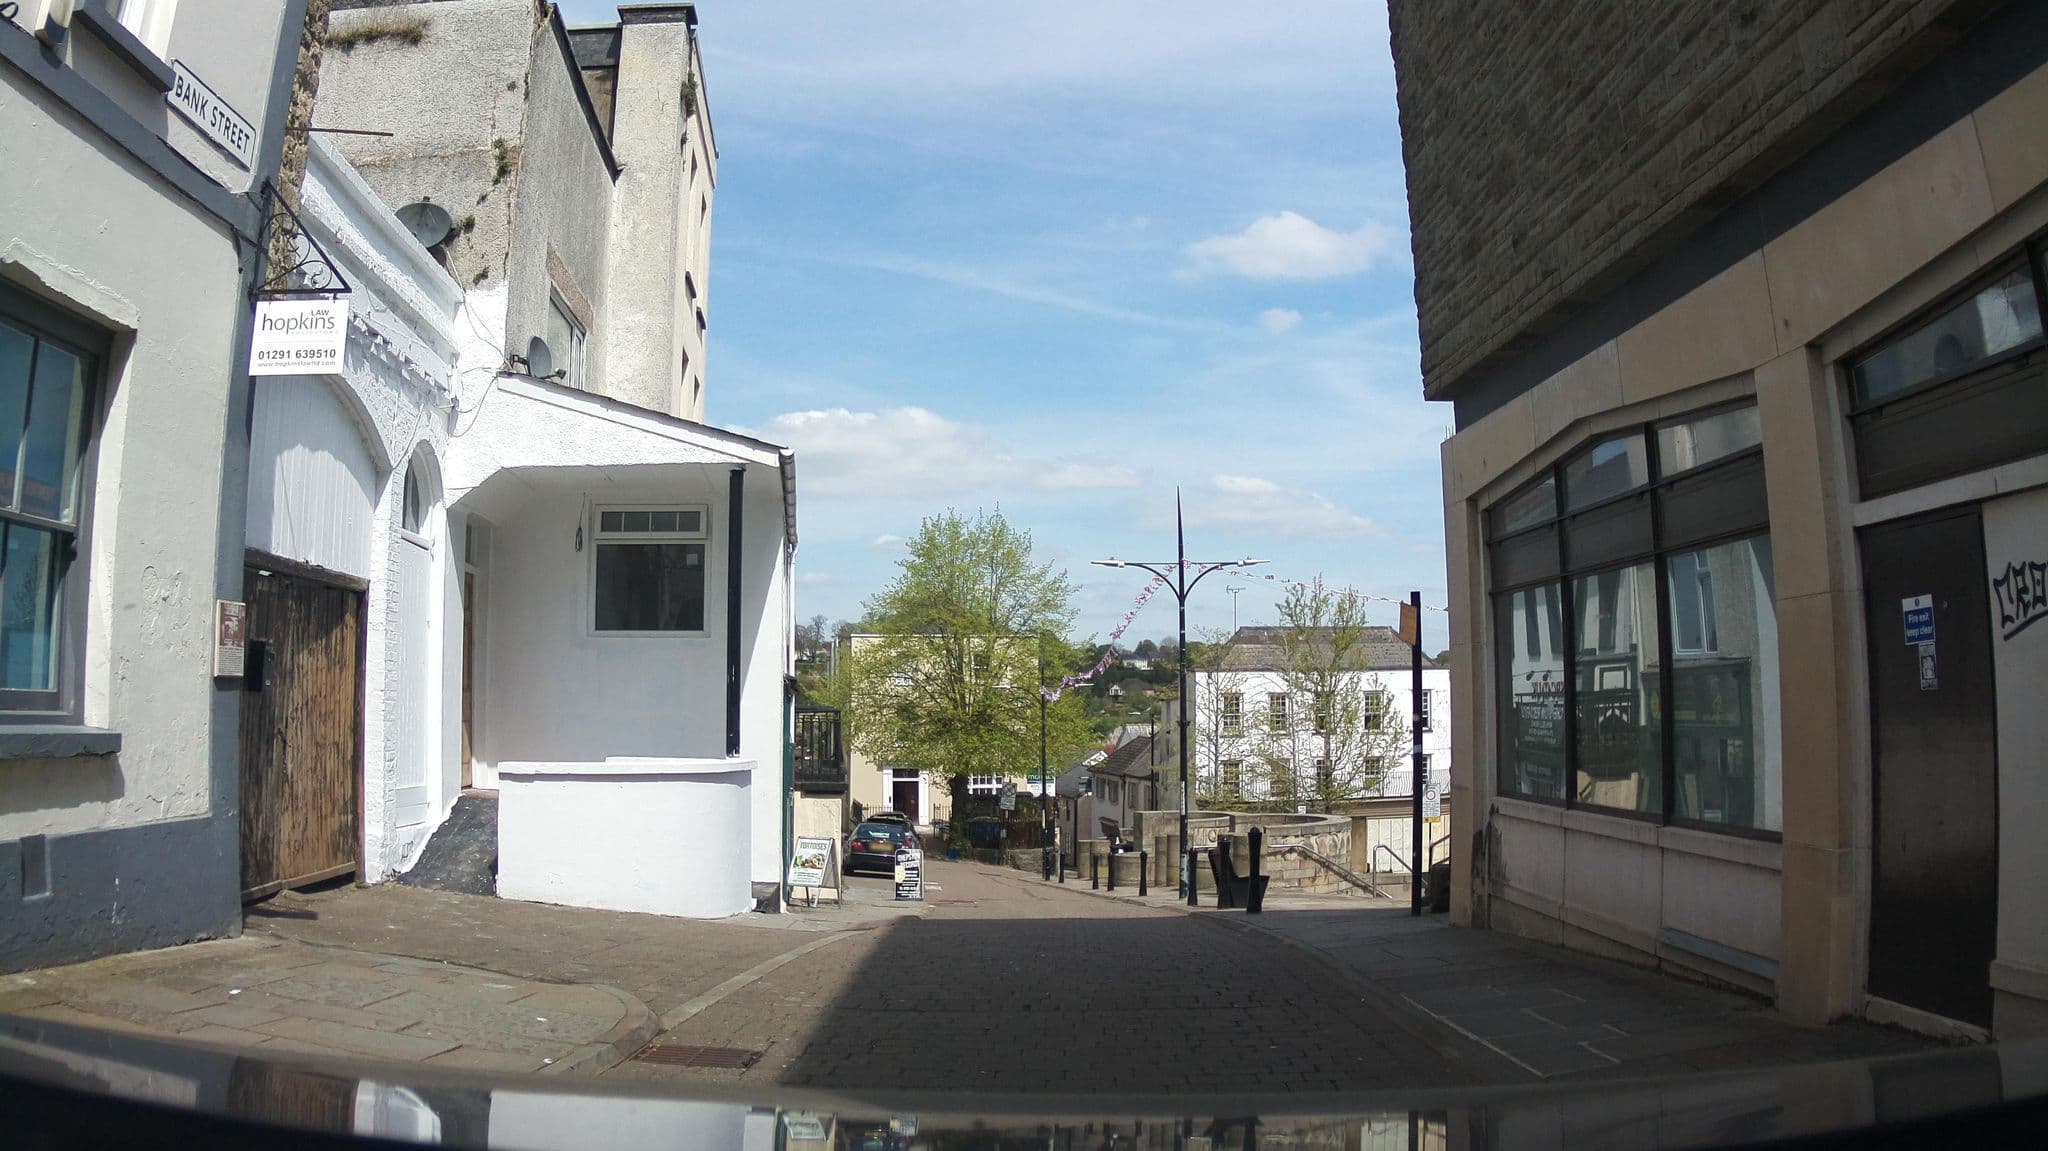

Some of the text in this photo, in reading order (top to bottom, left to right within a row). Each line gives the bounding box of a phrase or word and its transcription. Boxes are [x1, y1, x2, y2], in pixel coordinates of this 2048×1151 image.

[175, 74, 250, 154] BANK STREET
[262, 312, 335, 335] hopkins
[258, 349, 336, 360] 01291 639510
[1908, 611, 1930, 623] Fire exit
